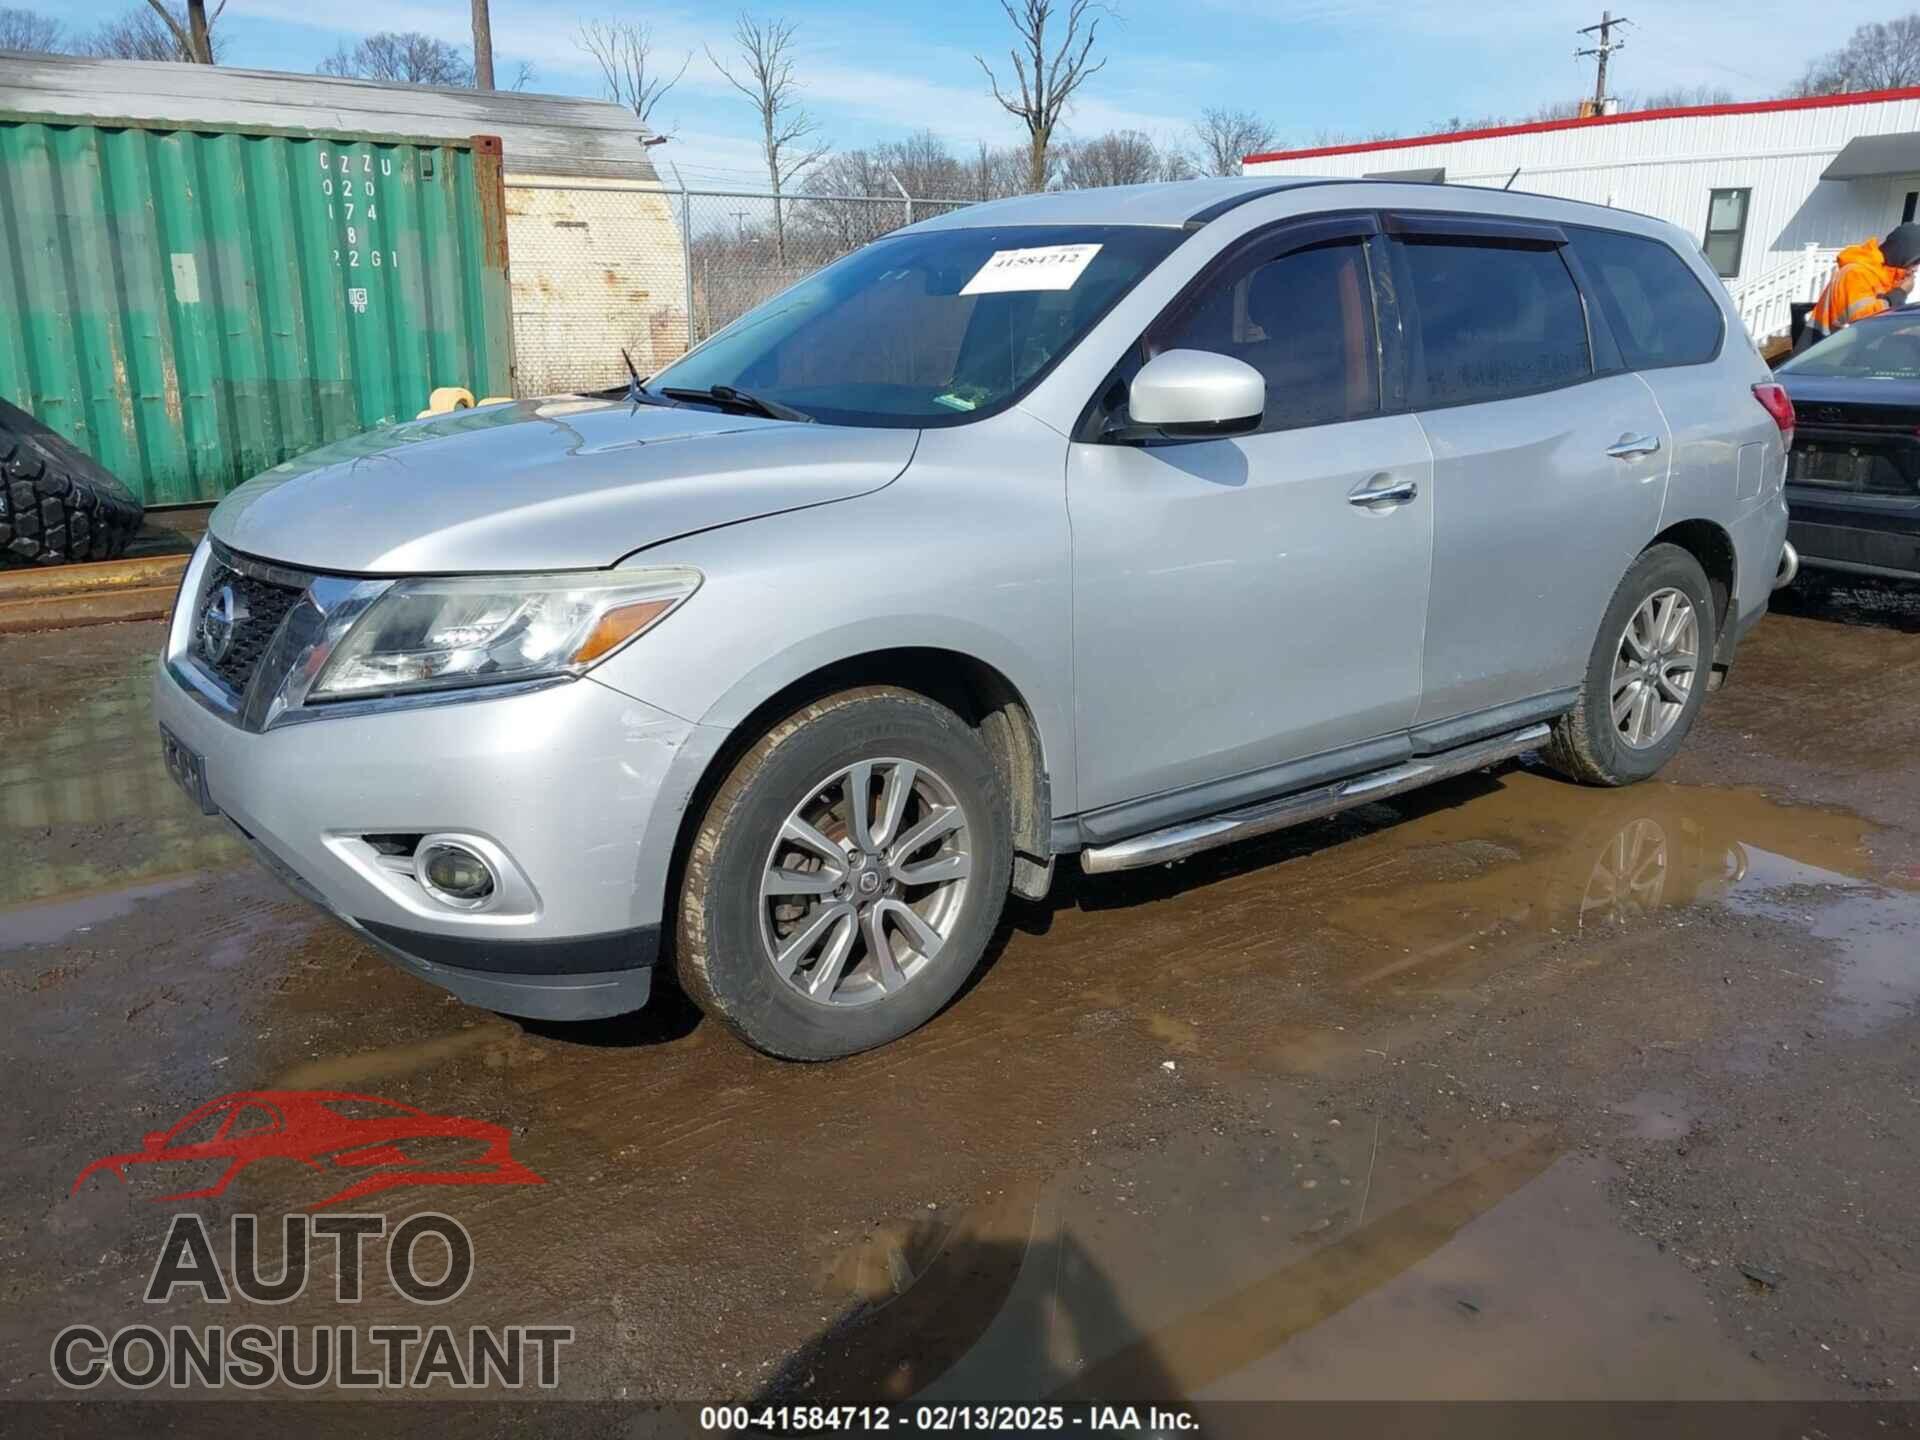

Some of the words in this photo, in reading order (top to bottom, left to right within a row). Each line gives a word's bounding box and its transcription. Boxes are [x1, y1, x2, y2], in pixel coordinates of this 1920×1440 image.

[319, 151, 392, 176] CZZU
[322, 178, 375, 197] 020
[347, 226, 356, 244] 8
